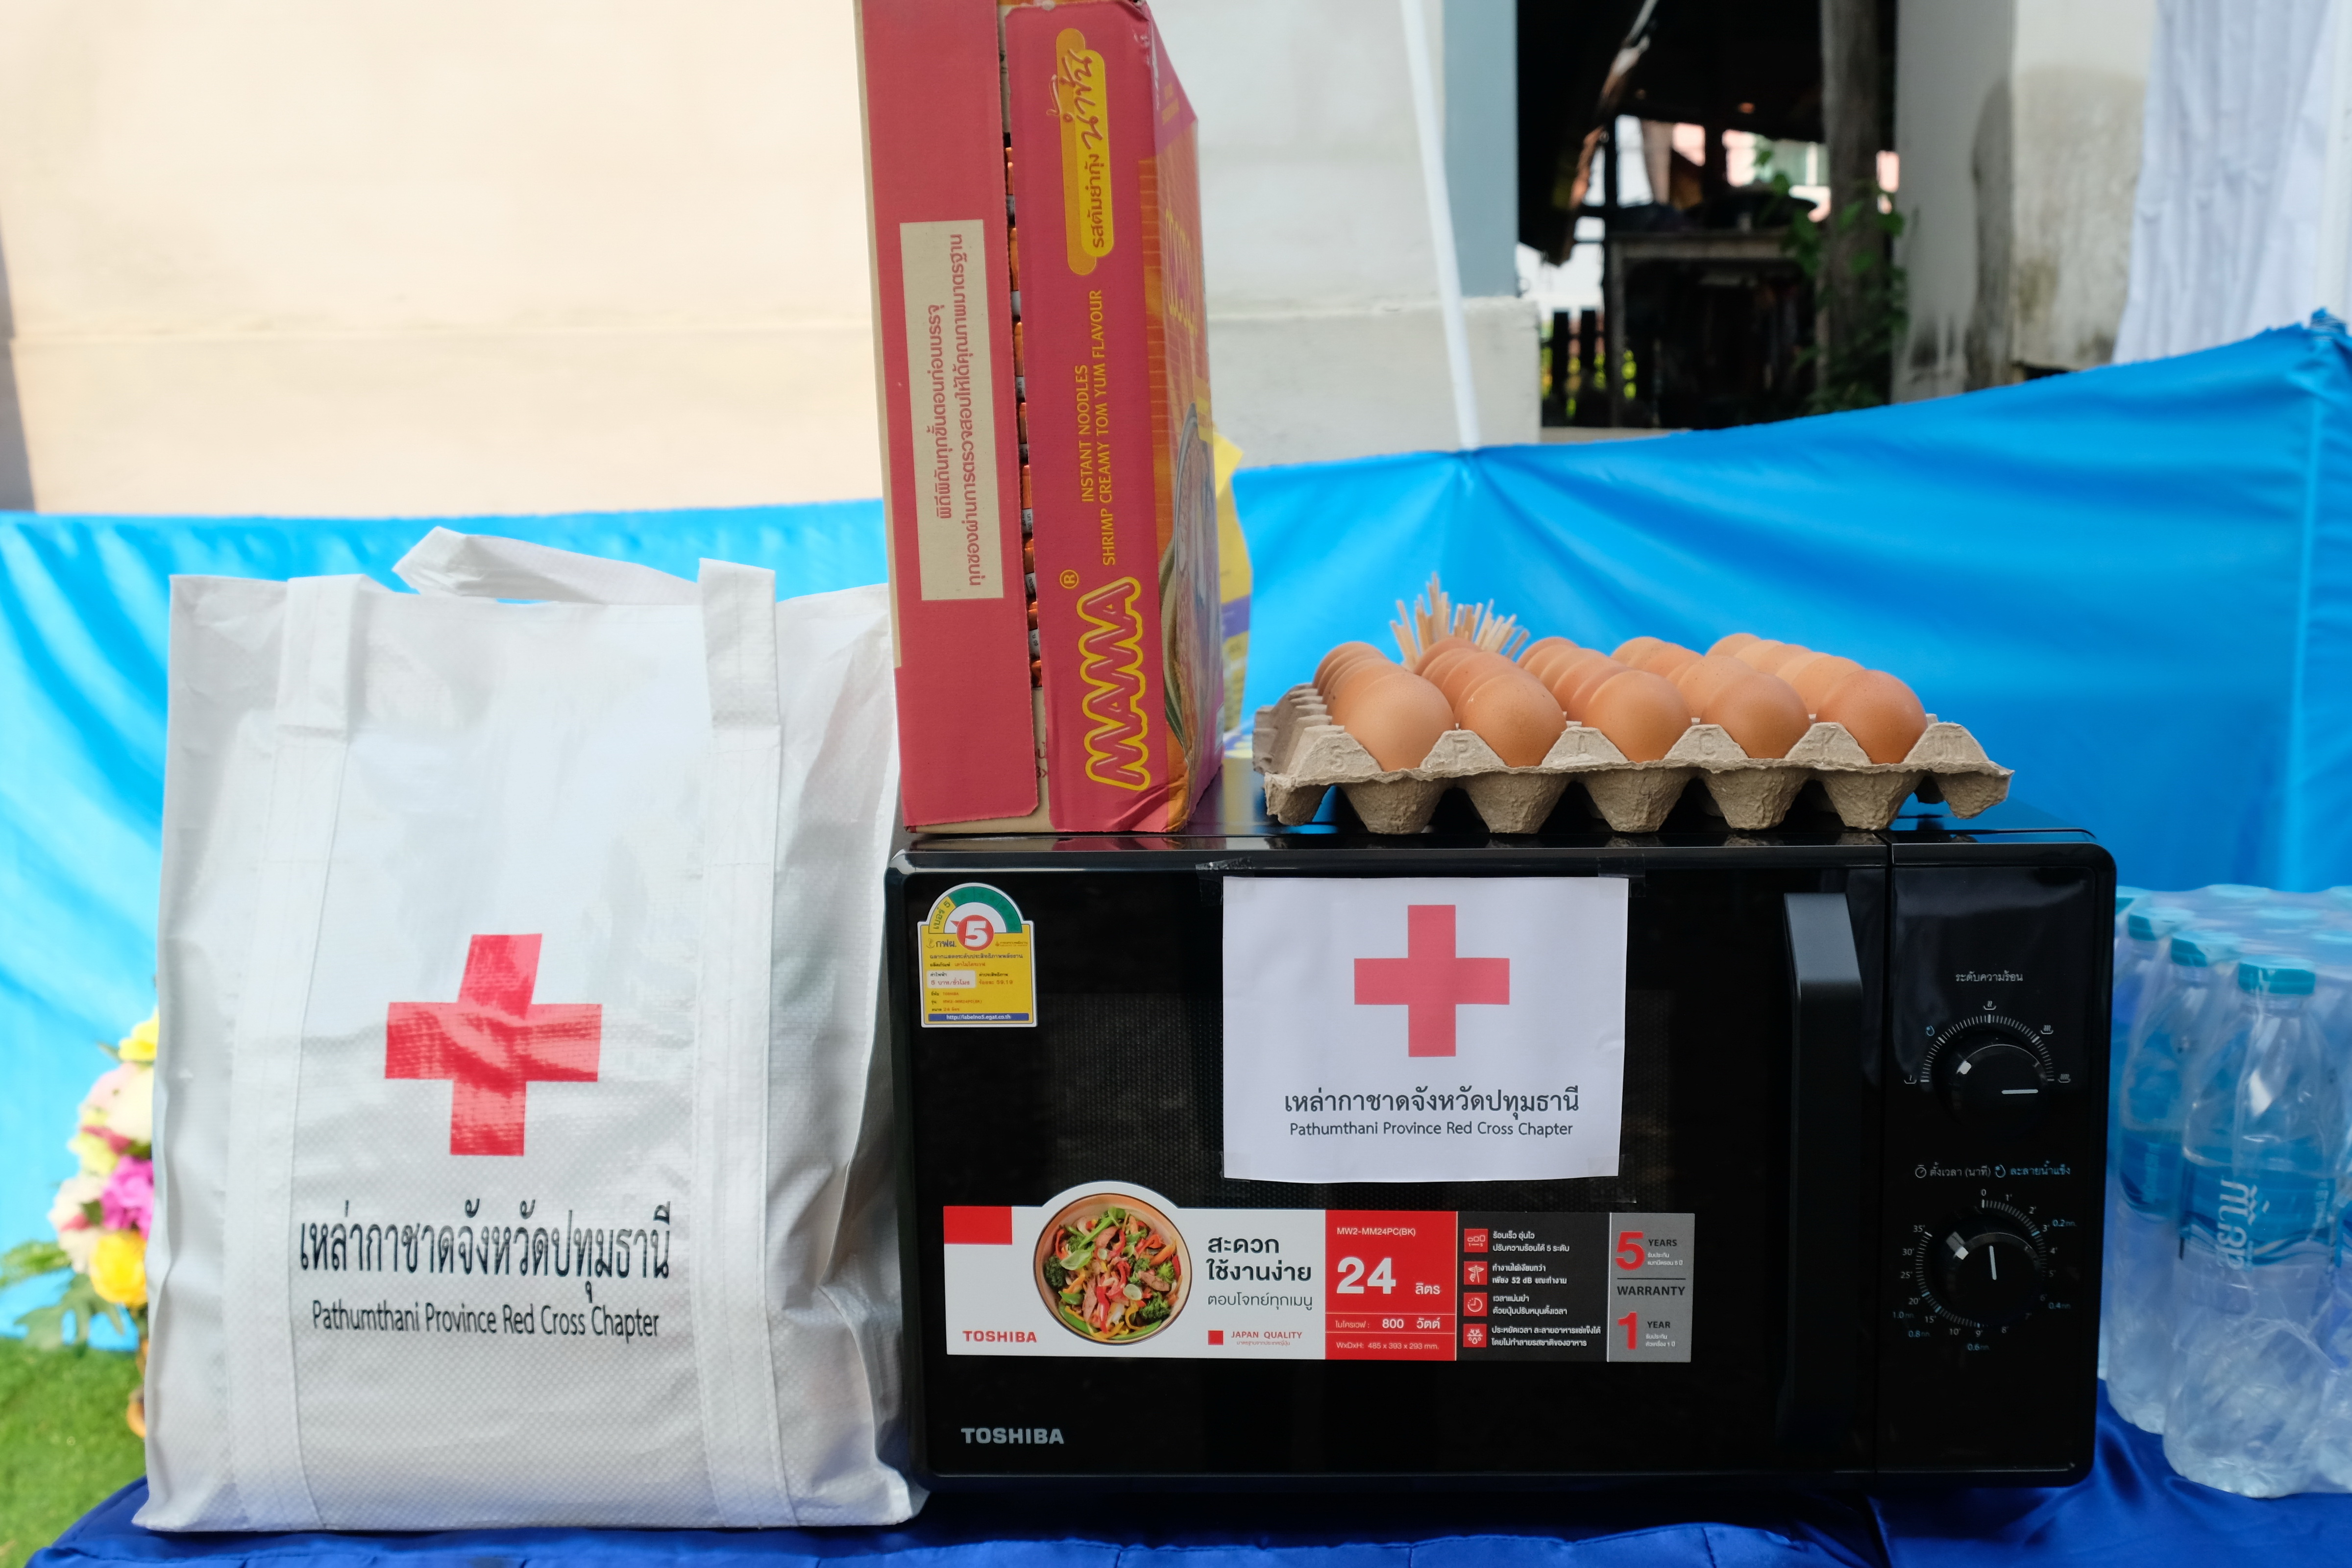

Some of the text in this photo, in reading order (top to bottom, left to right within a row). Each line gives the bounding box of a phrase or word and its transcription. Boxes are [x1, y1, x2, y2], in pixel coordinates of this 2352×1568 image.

[1085, 153, 1104, 248] รสต้มยำกุ้ง
[926, 304, 952, 519] พิถีพิถันทุกขั้นตอนก่อนบรรจุ
[950, 234, 981, 586] ทุกซองผ่านการตรวจสอบให้ได้คุณภาพมาตรฐาน
[1075, 365, 1094, 502] INSTANT NOODLES
[1089, 290, 1115, 565] SHRIMP CREAMY TOM YUM FLAVOUR
[1077, 576, 1151, 791] MAMA
[932, 906, 945, 929] เบอร์
[964, 920, 988, 948] 5
[1956, 970, 2023, 981] ระดับความร้อน
[1285, 1085, 1579, 1120] เหล่ากาชาดจังหวัดปทุมธานี
[1290, 1121, 1573, 1138] Pathumthani Province Red Cross Chapter
[1930, 1161, 1991, 1177] ตั้งเวลา (นาที)
[2010, 1160, 2071, 1175] ละลายน้ำแข็ง
[1337, 1227, 1416, 1236] MW2-MM24PC(BK)
[1493, 1230, 1535, 1241] ร้อนเร็ว อุ่นไว
[300, 1199, 670, 1303] เหล่ากาชาดจังหวัดปทุมธานี
[1207, 1238, 1279, 1254] สะดวก
[1493, 1243, 1545, 1251] ปรับความร้อนได้
[1615, 1231, 1645, 1271] 5
[1206, 1258, 1311, 1281] ใช้งานง่าย
[1337, 1256, 1440, 1295] 24 ลิตร
[1492, 1263, 1546, 1272] ทำงานได้เงียบกว่า
[1535, 1276, 1567, 1284] ขณะทำงาน
[1617, 1286, 1686, 1296] WARRANTY
[1207, 1292, 1313, 1311] ตอบโจทย์ทุกเมนู
[1493, 1305, 1567, 1317] ด้วยปุ่มปรับหมุนตั้งเวลา
[312, 1299, 659, 1344] Pathumthani Province Red Cross Chapter
[1382, 1319, 1404, 1328] 800
[1417, 1317, 1441, 1329] วัตต์
[1492, 1325, 1601, 1334] ประหยัดเวลา ละลายอาหารแช่แข็งได้
[962, 1330, 1037, 1343] TOSHIBA
[1618, 1311, 1637, 1350] 1
[1492, 1338, 1587, 1347] โดยไม่ทำลายรสชาติของอาหาร
[961, 1428, 1064, 1444] TOSHIBA
